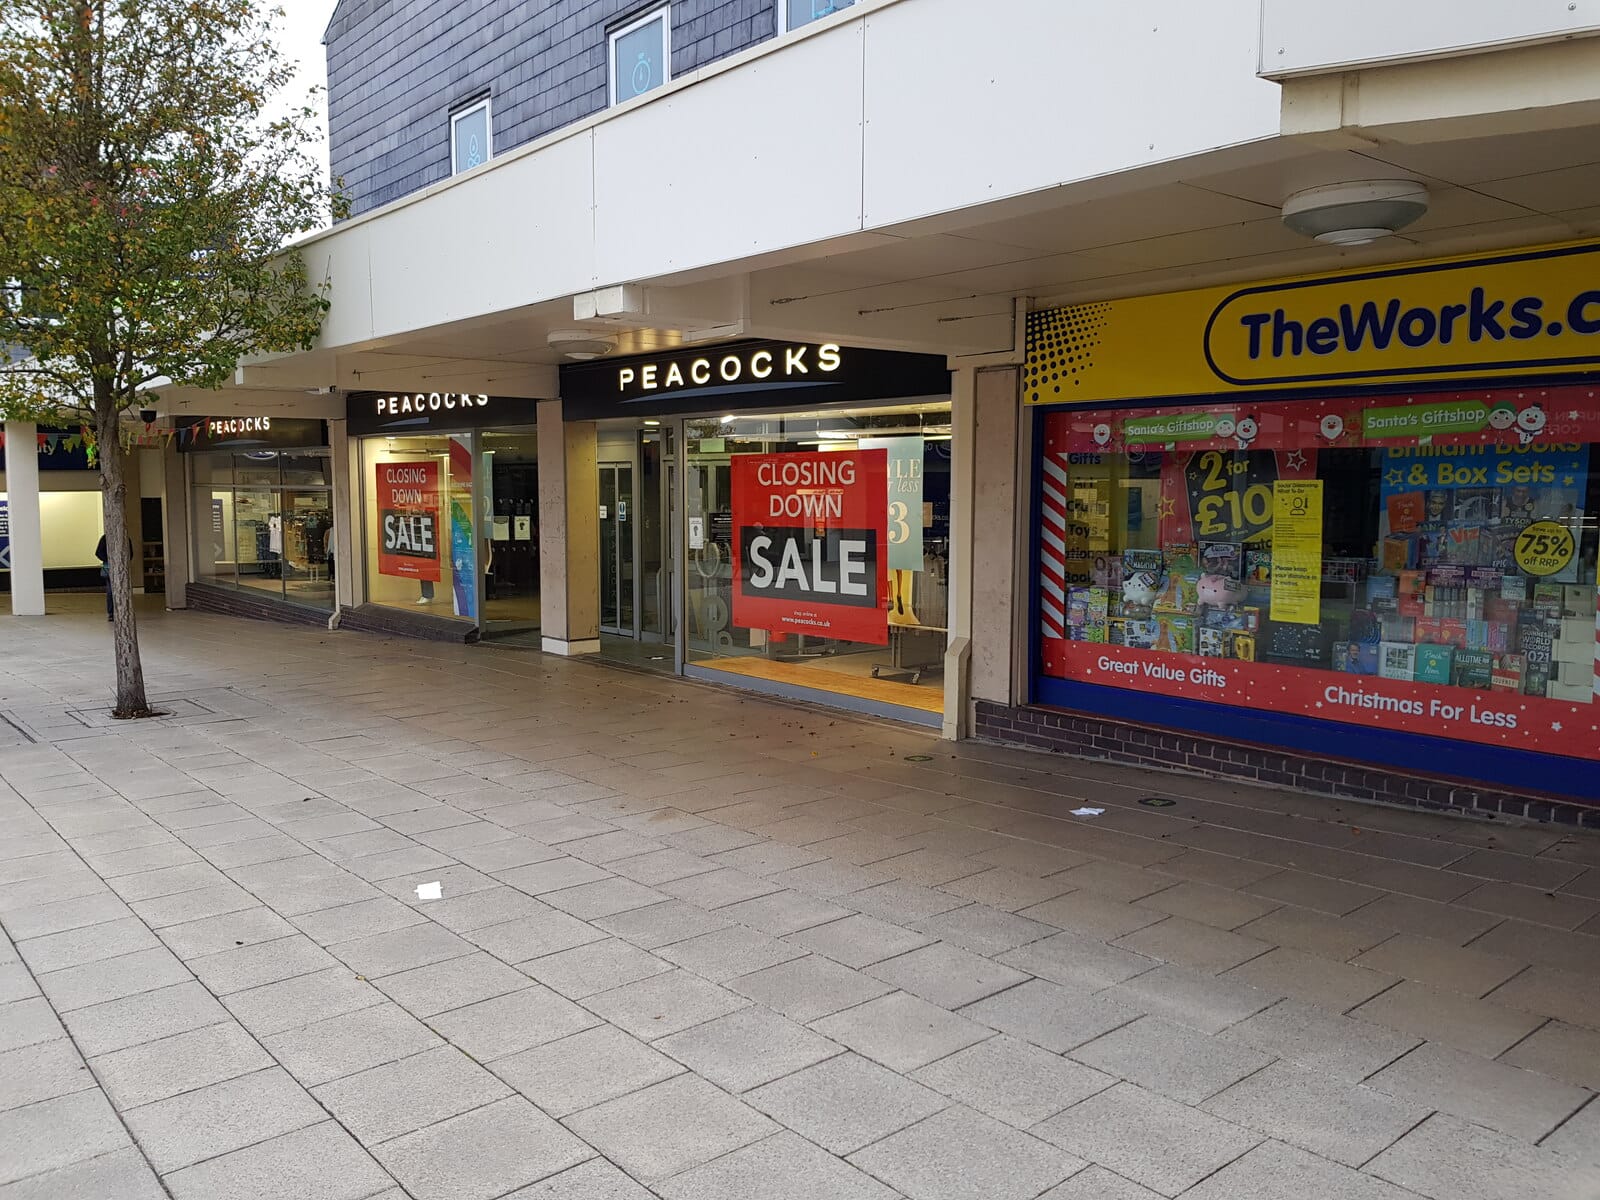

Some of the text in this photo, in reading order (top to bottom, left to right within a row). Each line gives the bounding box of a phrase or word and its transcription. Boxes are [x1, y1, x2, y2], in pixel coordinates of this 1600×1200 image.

[618, 343, 842, 392] PEACOCKS
[376, 393, 490, 416] PEACOCKS
[209, 416, 271, 435] PEACOCKS
[1127, 420, 1214, 437] Santa's Giftshop
[1366, 405, 1487, 429] Santa's Giftshop
[386, 468, 427, 485] CLOSING
[757, 460, 856, 487] CLOSING
[1199, 450, 1250, 492] 2 for
[1407, 459, 1556, 485] & Box Sets
[391, 488, 422, 505] DOWN
[897, 477, 920, 493] less
[769, 494, 842, 518] DOWN
[1194, 484, 1274, 536] £10
[384, 514, 434, 552] SALE
[888, 500, 910, 545] 3
[1068, 523, 1098, 538] Toys
[1520, 533, 1569, 557] 75%
[749, 535, 868, 596] SALE
[1523, 556, 1559, 567] off RRP
[1522, 635, 1550, 646] WORLD
[1520, 649, 1550, 663] 2021
[1097, 655, 1227, 688] Great Value Gifts
[1324, 685, 1517, 729] Christmas For Less
